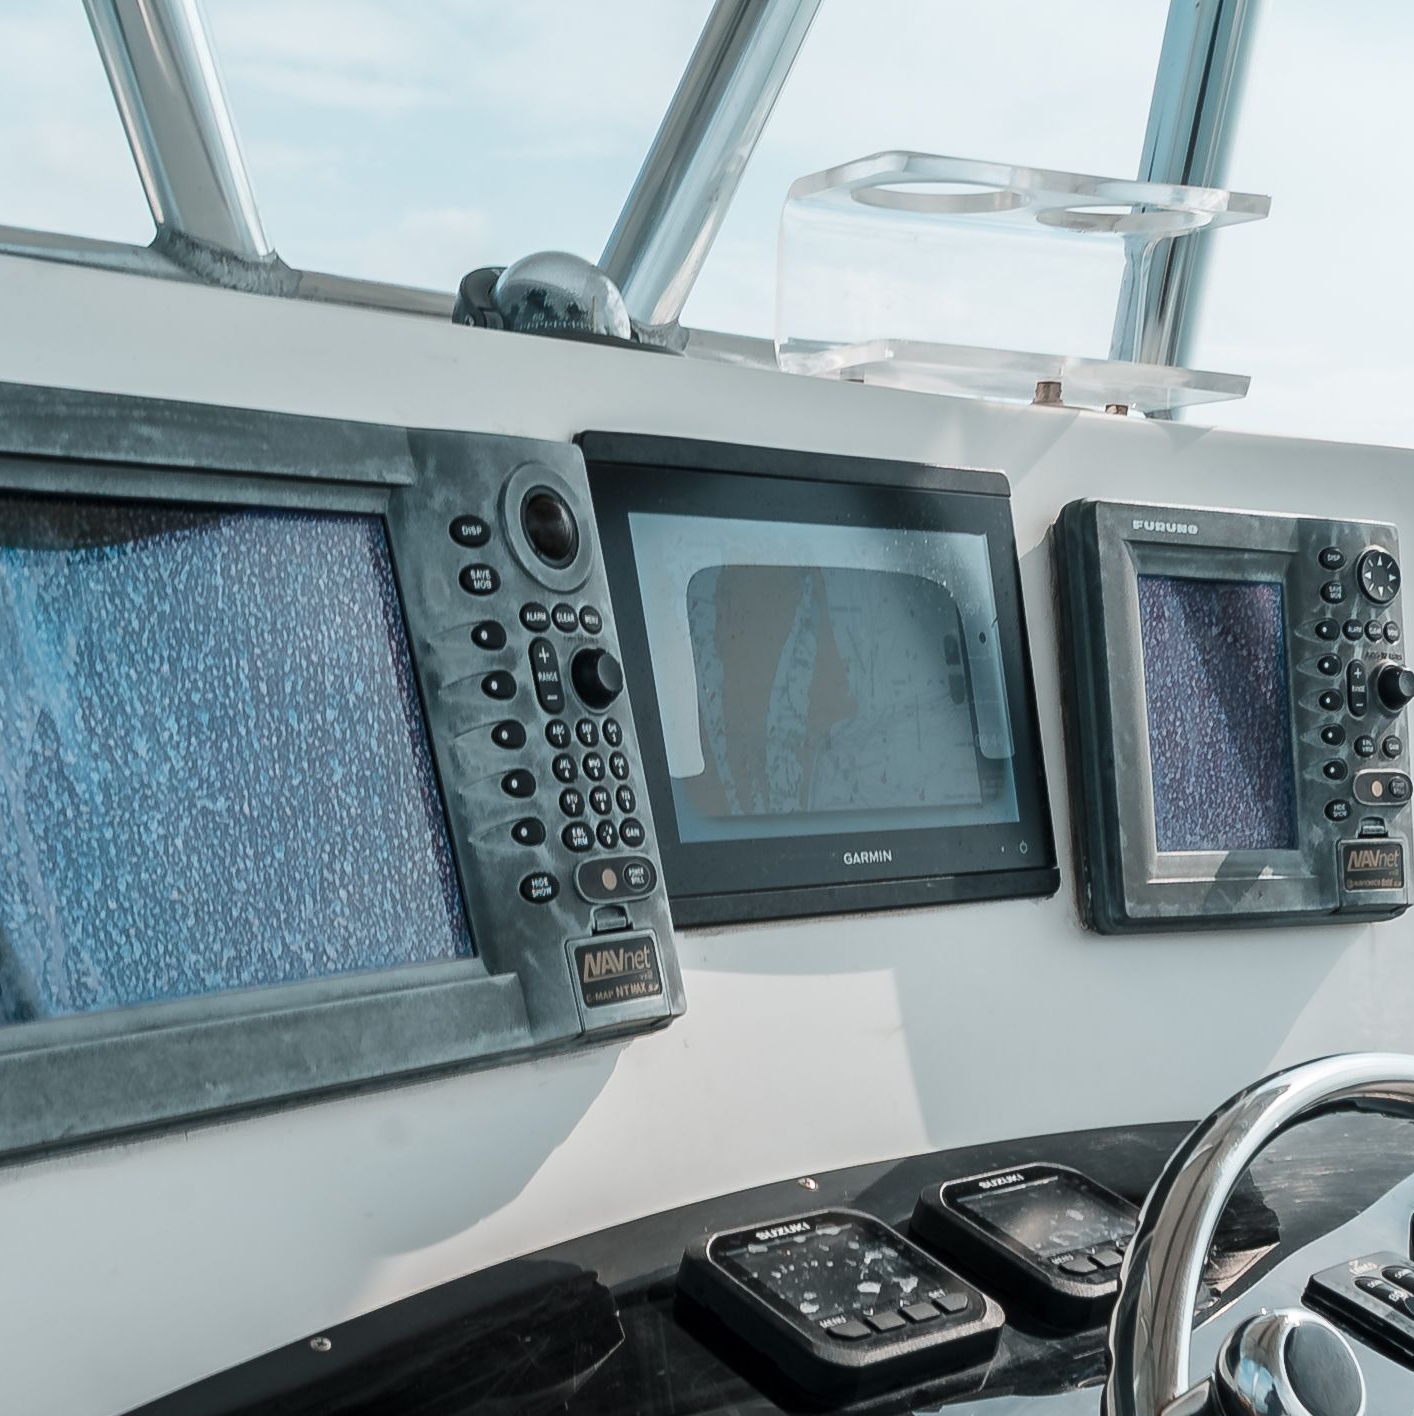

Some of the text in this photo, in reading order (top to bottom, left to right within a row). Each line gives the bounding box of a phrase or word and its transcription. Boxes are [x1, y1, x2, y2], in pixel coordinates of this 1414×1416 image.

[461, 524, 482, 536] DISP
[1132, 519, 1199, 535] FURUNO
[843, 849, 893, 866] GARMIN
[1347, 849, 1400, 872] NAVnet
[583, 944, 651, 983] NAVnet
[978, 1173, 1025, 1189] SUZUKI
[755, 1221, 811, 1241] SUZUKI
